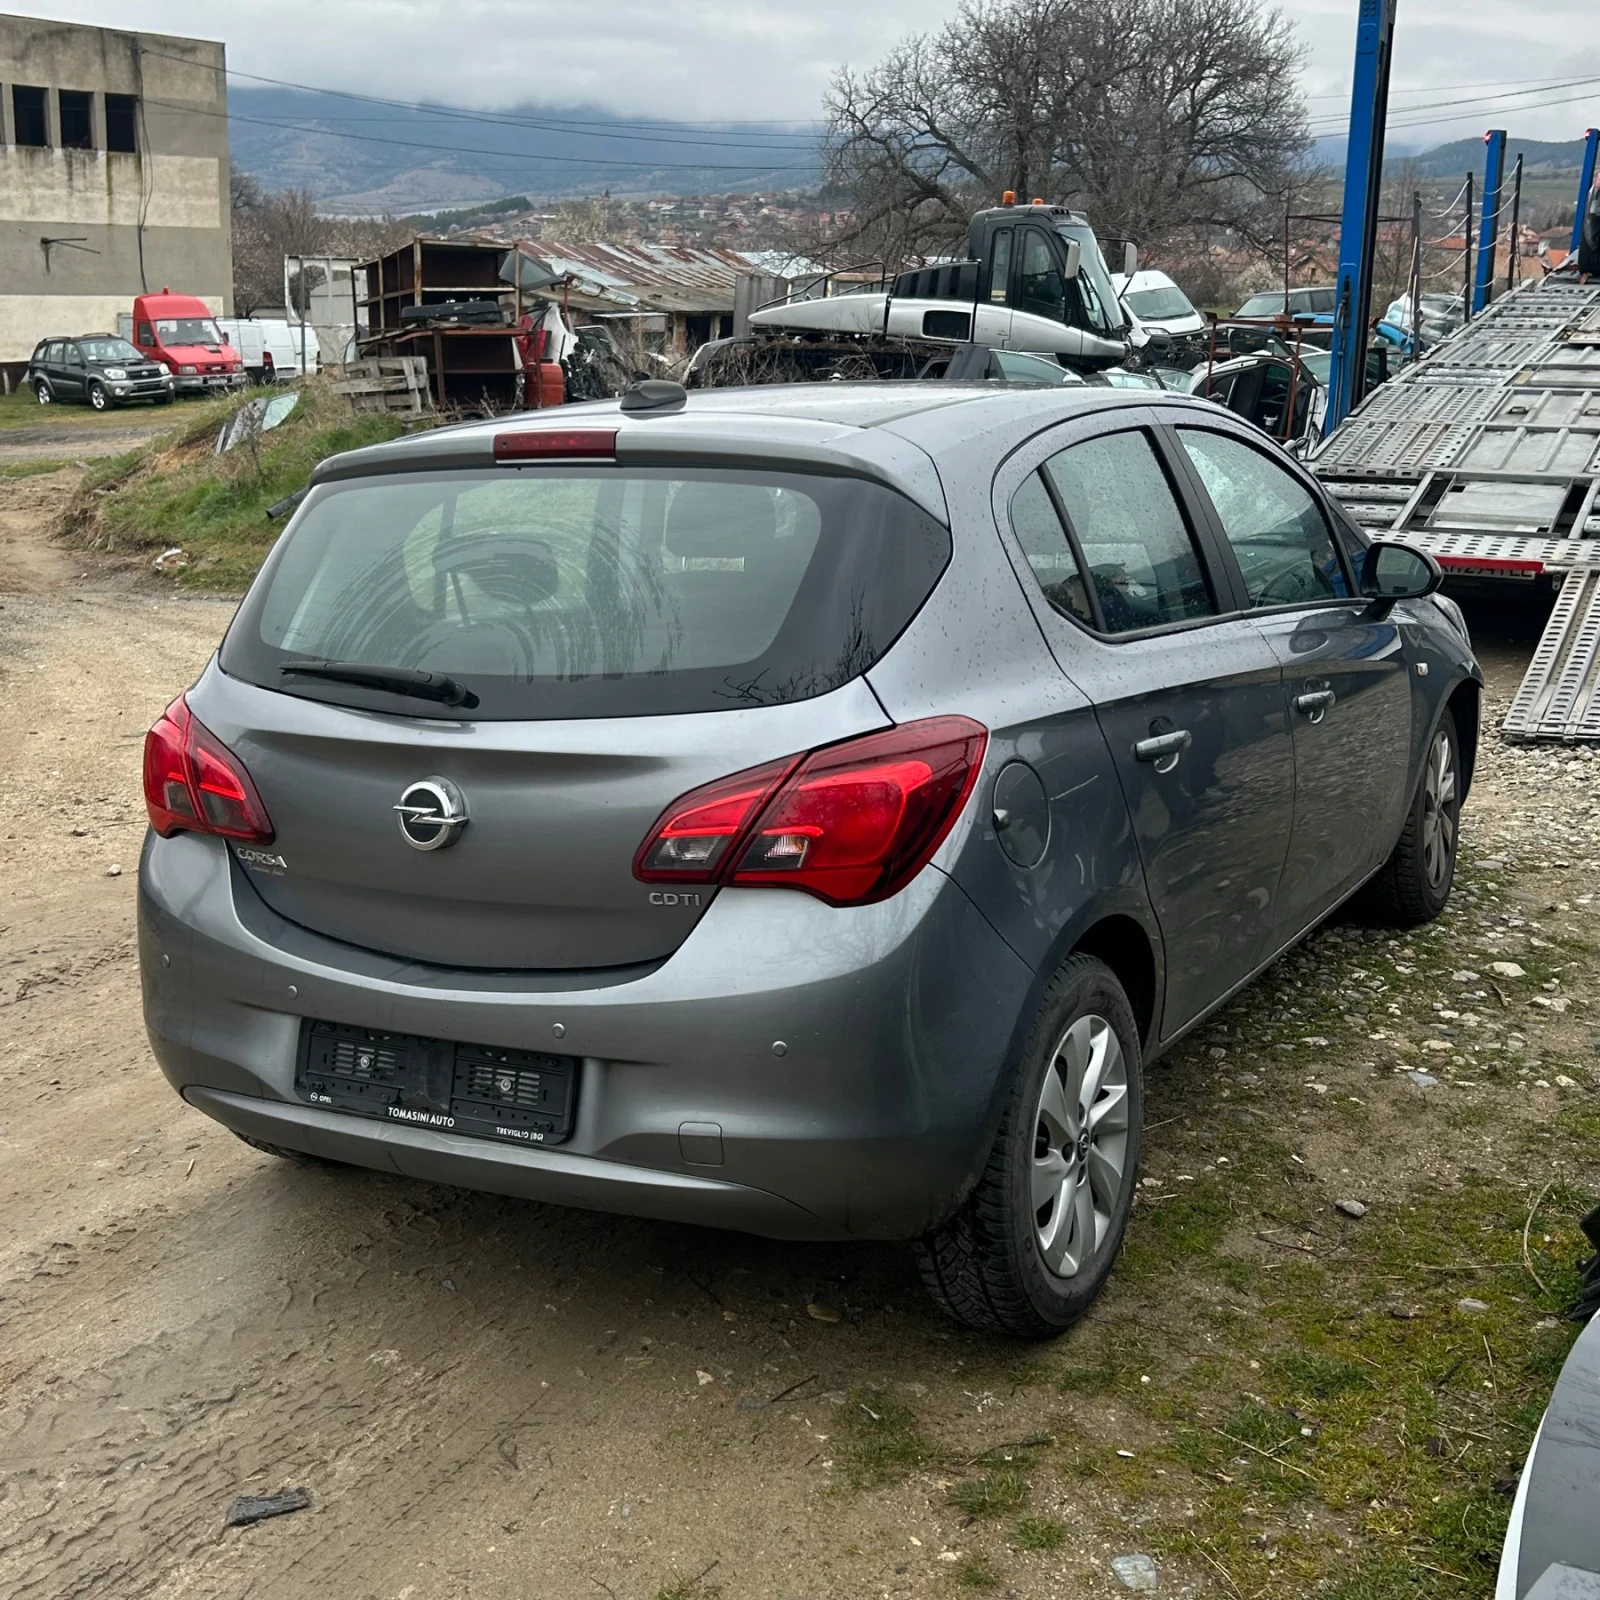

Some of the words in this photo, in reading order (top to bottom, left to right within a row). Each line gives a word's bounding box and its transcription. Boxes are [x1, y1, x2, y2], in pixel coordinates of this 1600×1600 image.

[236, 847, 288, 869] CORSA
[648, 892, 701, 907] CDTI
[388, 1106, 430, 1123] TOMASINI
[429, 1114, 455, 1128] AUTO
[496, 1126, 529, 1139] TREVIGLIO
